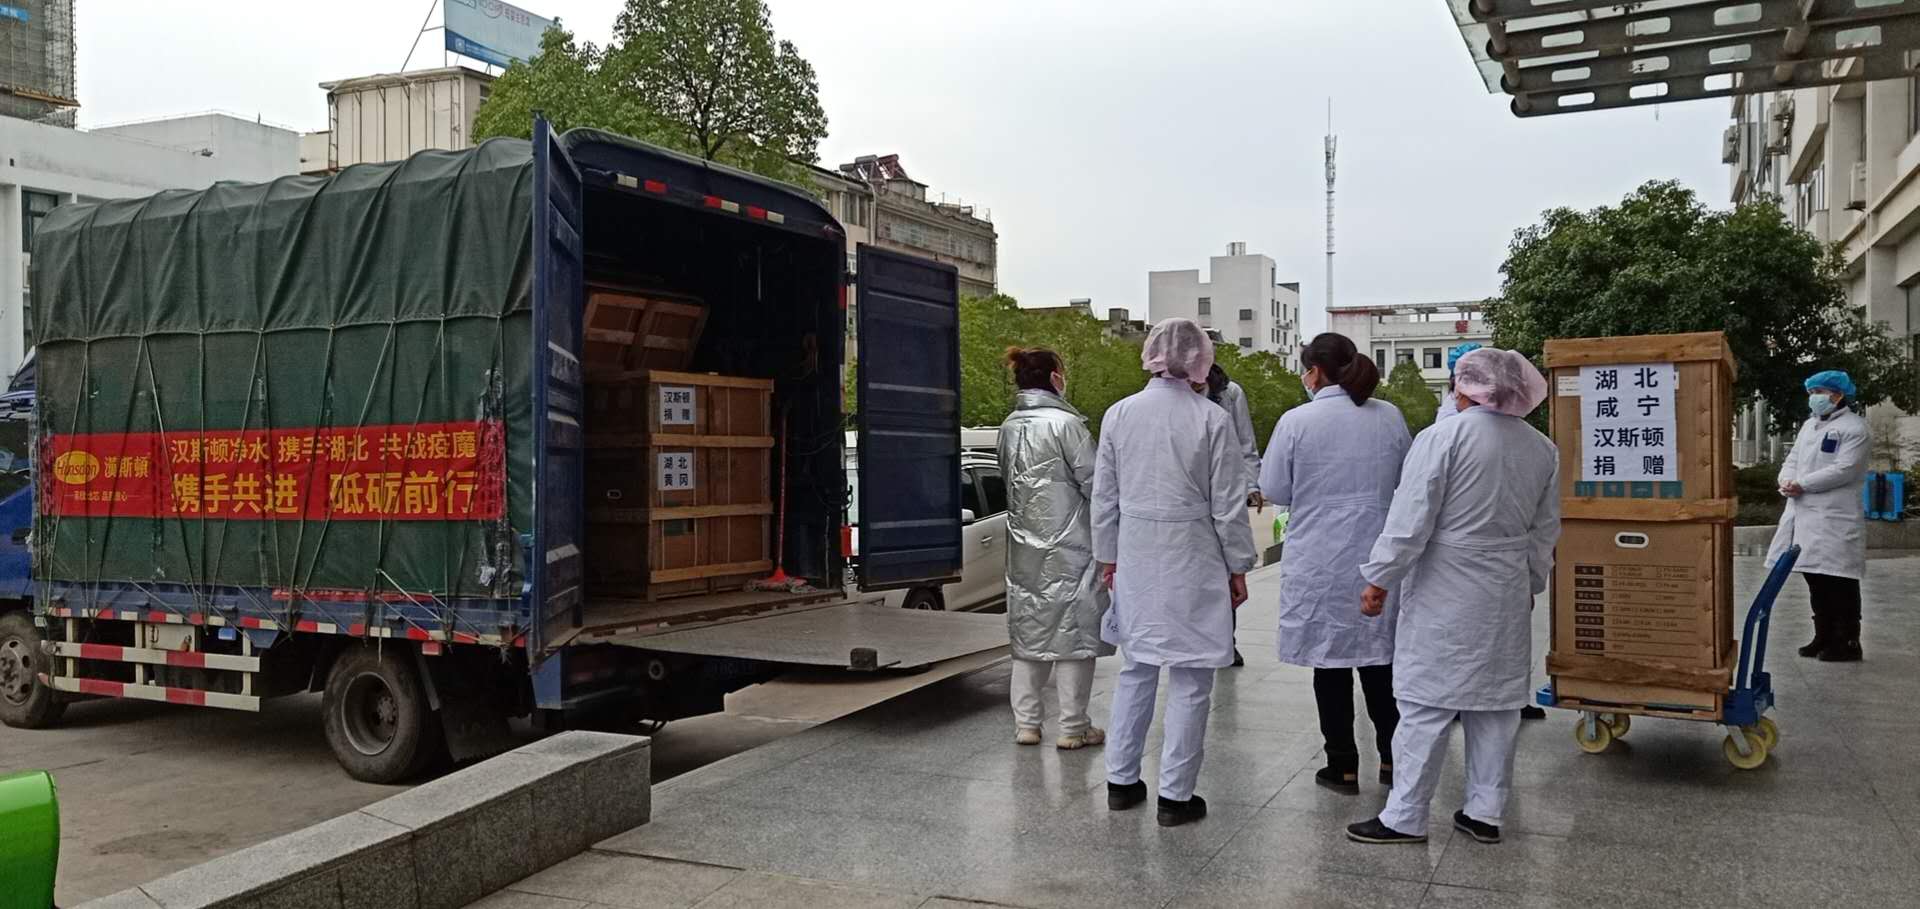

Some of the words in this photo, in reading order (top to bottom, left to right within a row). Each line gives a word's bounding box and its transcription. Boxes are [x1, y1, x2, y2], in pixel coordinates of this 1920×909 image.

[1595, 367, 1658, 390] 湖北
[663, 391, 690, 404] 汉斯顿
[1596, 395, 1660, 418] 咸宁
[171, 437, 269, 464] 汉斯顿净水
[278, 435, 369, 463] 携手湖北
[379, 430, 477, 460] 共战疫魔
[1593, 427, 1664, 447] 汉斯顿
[663, 456, 688, 470] 湖北
[1593, 455, 1664, 476] 捐赠
[663, 473, 689, 487] 黄冈
[171, 473, 298, 514] 携手共进
[329, 470, 479, 514] 砥砺前行
